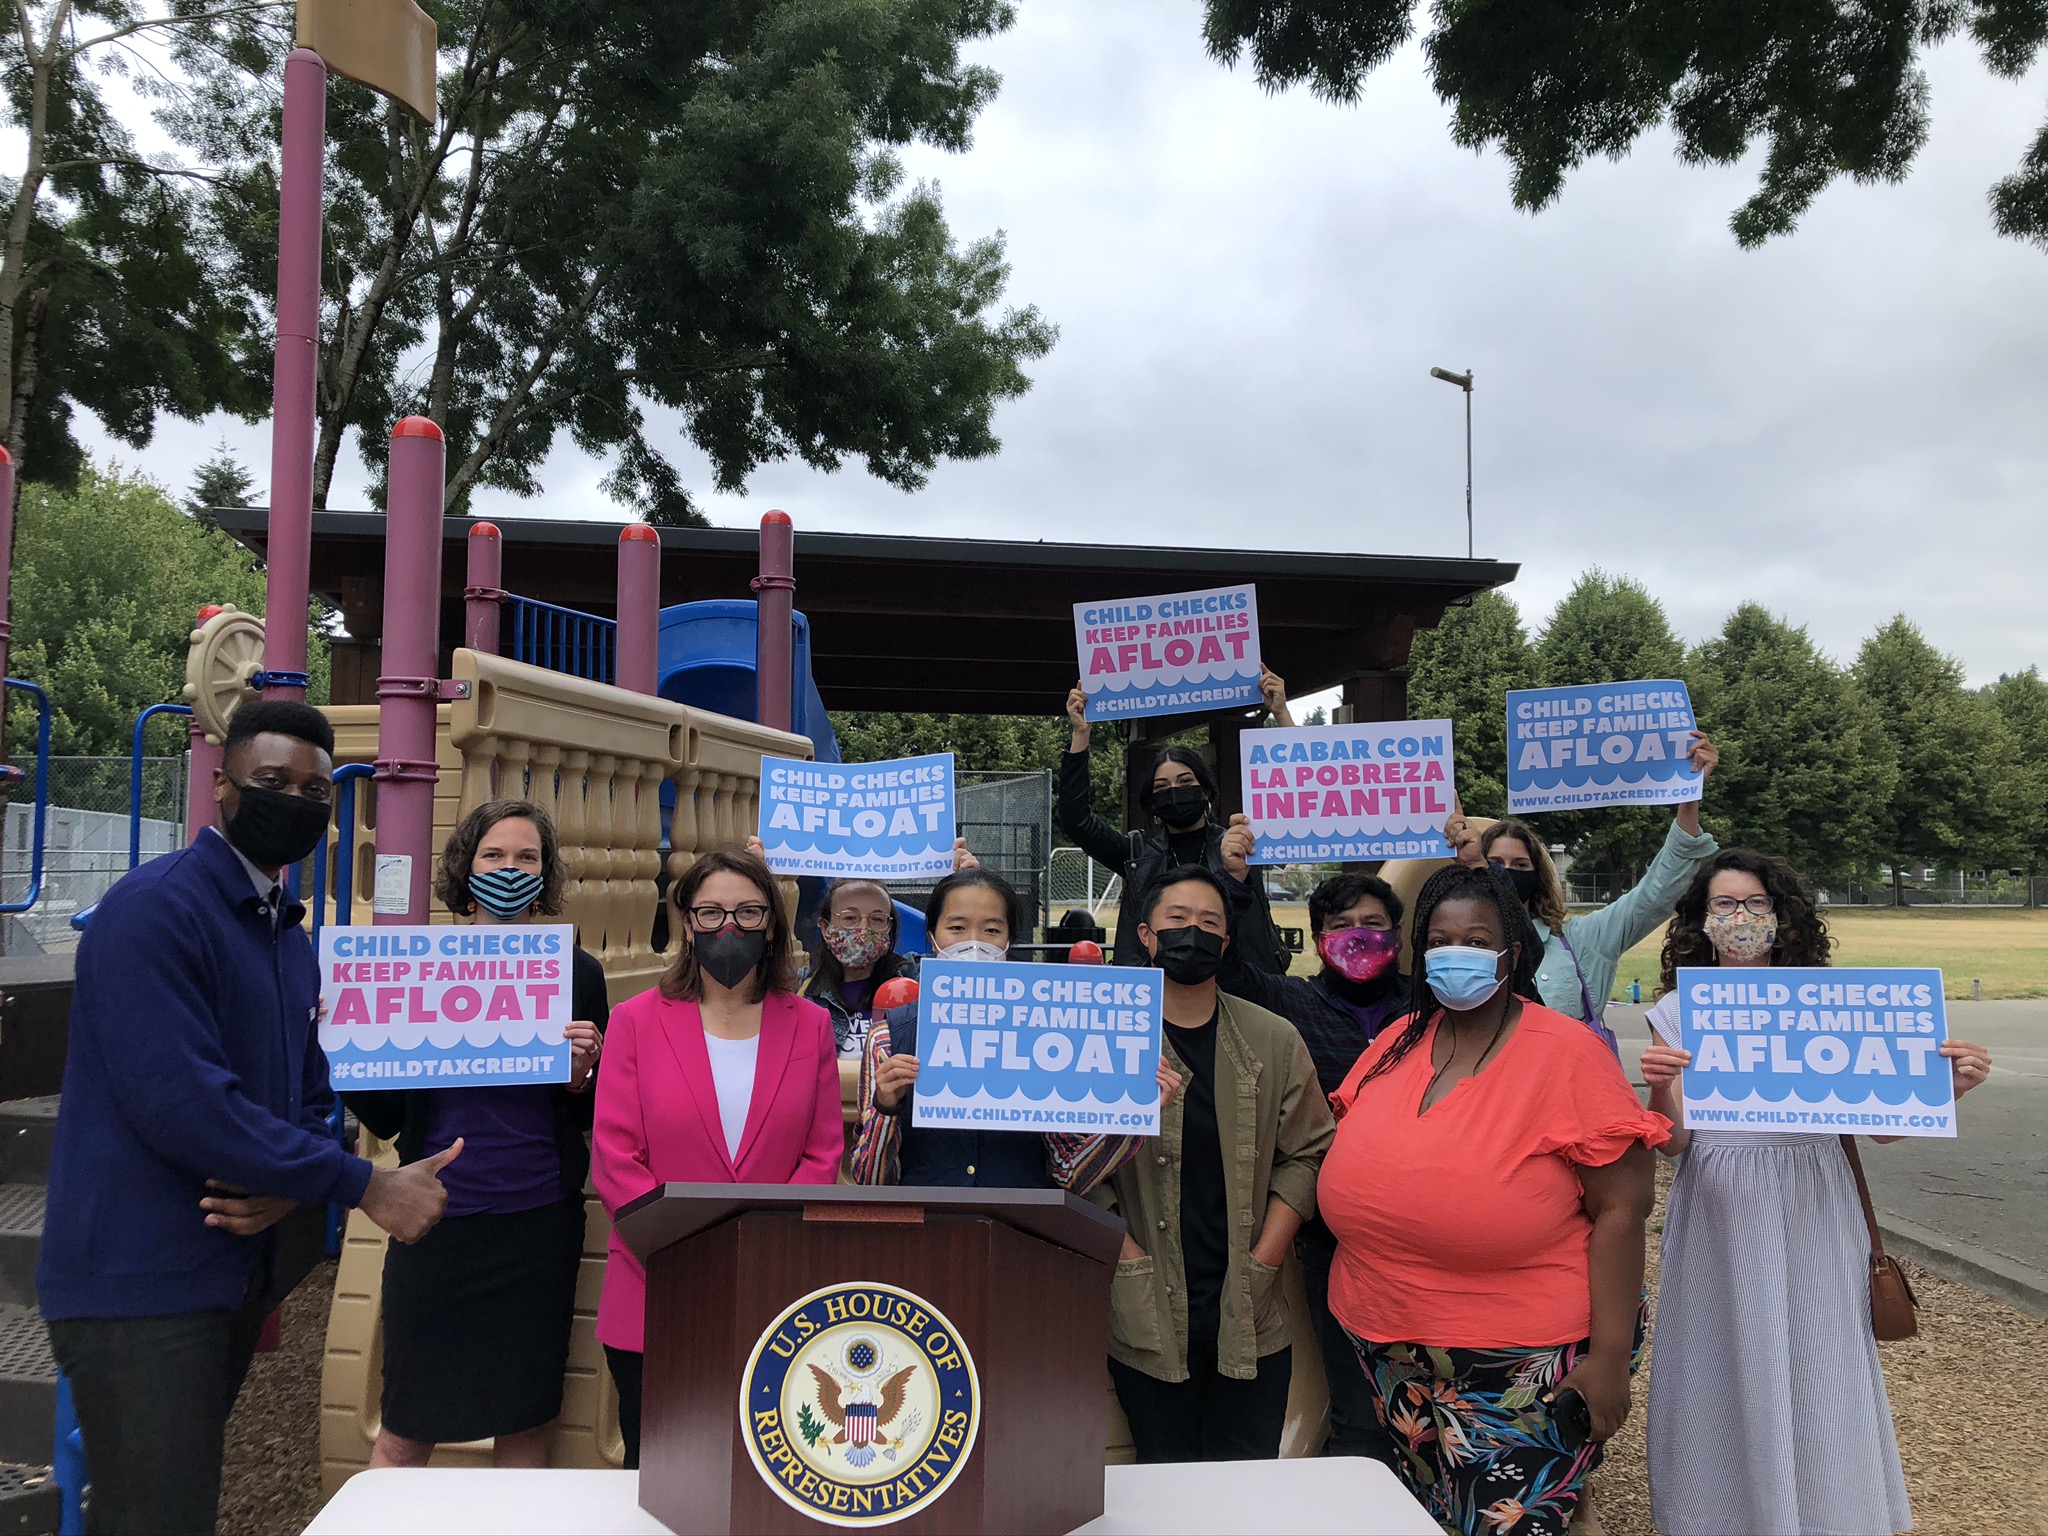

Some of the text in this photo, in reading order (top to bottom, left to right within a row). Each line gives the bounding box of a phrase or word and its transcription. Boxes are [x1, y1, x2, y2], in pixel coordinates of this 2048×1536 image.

[1084, 592, 1248, 625] CHILD CHECKS
[1086, 613, 1249, 645] KEEP FAMILIES
[1089, 631, 1250, 675] AFLOAT
[1096, 685, 1251, 712] #CHILDTAXCREDIT
[1517, 691, 1685, 720] CHILD CHECKS
[1517, 711, 1690, 739] KEEP FAMILIES
[1249, 736, 1443, 764] ACABAR CON
[1517, 730, 1695, 770] AFLOAT
[770, 765, 945, 790] CHILD CHECKS
[1251, 761, 1445, 789] LA POBREZA
[770, 784, 945, 807] KEEP FAMILIES
[1252, 786, 1446, 820] INFANTIL
[1513, 786, 1699, 807] WWW.CHILDTAXCREDIT.GOV
[769, 802, 945, 837] AFLOAT
[1261, 840, 1439, 859] #CHILDTAXCREDIT
[333, 934, 561, 957] CHILD CHECKS
[333, 959, 560, 983] KEEP FAMILIES
[330, 984, 559, 1025] AFLOAT
[932, 975, 1151, 1006] CHILD CHECKS
[1691, 983, 1932, 1007] CHILD CHECKS
[931, 1003, 1151, 1032] KEEP FAMILIES
[1692, 1010, 1935, 1033] KEEP FAMILIES
[928, 1028, 1150, 1075] AFLOAT
[1694, 1035, 1936, 1076] AFLOAT
[333, 1056, 554, 1079] #CHILDTAXCREDIT
[919, 1106, 1154, 1126] WWW.CHILDTAXCREDIT.GOV
[1689, 1109, 1948, 1128] WWW.CHILDTAXCREDIT.GOV
[769, 1293, 962, 1371] U.S. HOUSE OF
[755, 1407, 968, 1512] REPRESENTATIVES
